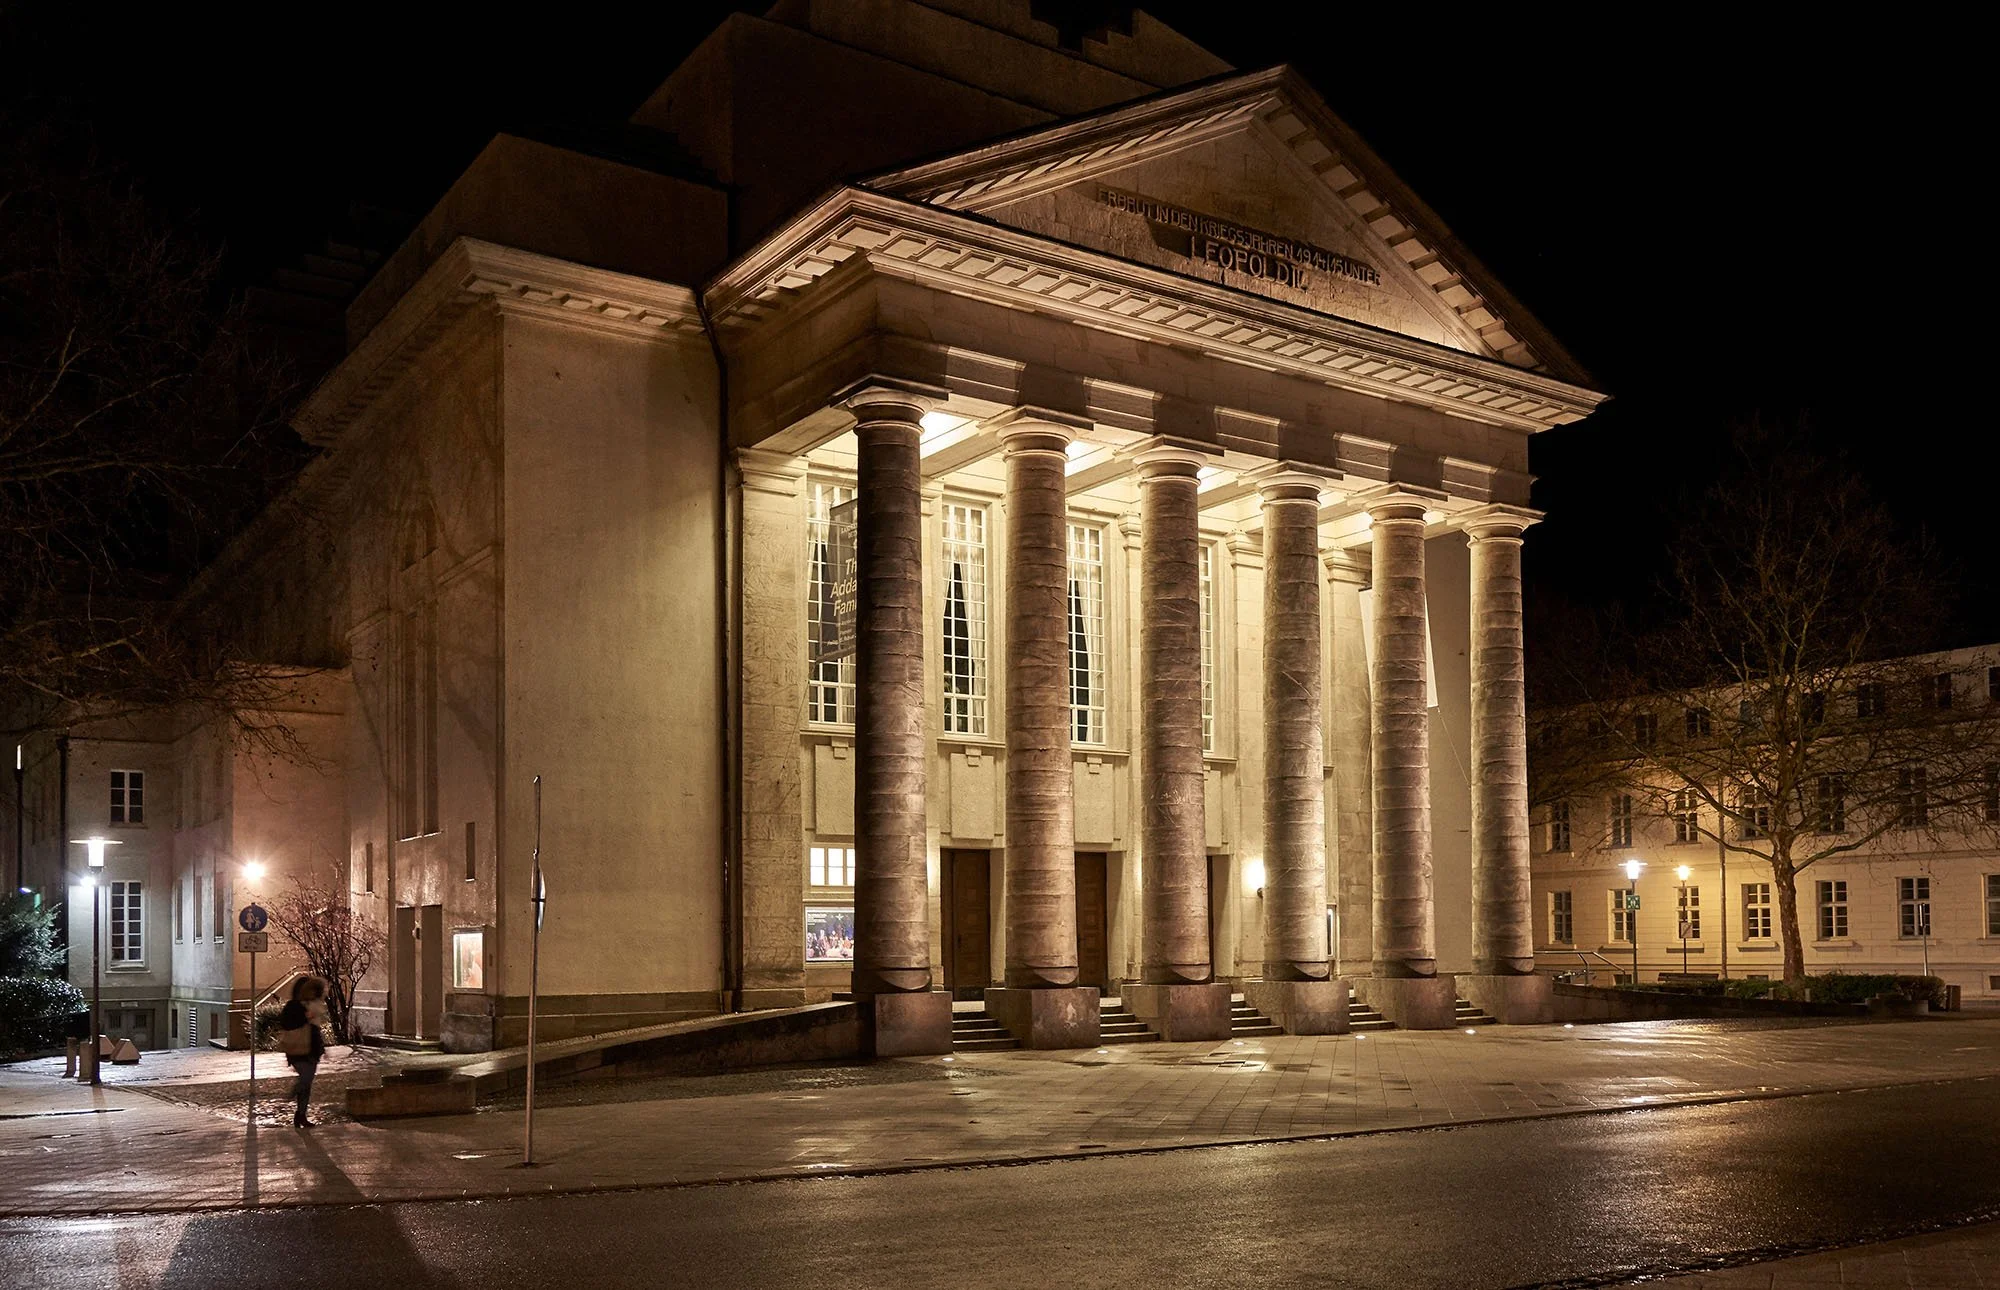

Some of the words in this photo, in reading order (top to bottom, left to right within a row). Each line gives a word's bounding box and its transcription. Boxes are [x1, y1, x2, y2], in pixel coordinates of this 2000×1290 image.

[1171, 210, 1198, 232] DEN
[845, 557, 857, 575] Th
[830, 578, 857, 598] Adda
